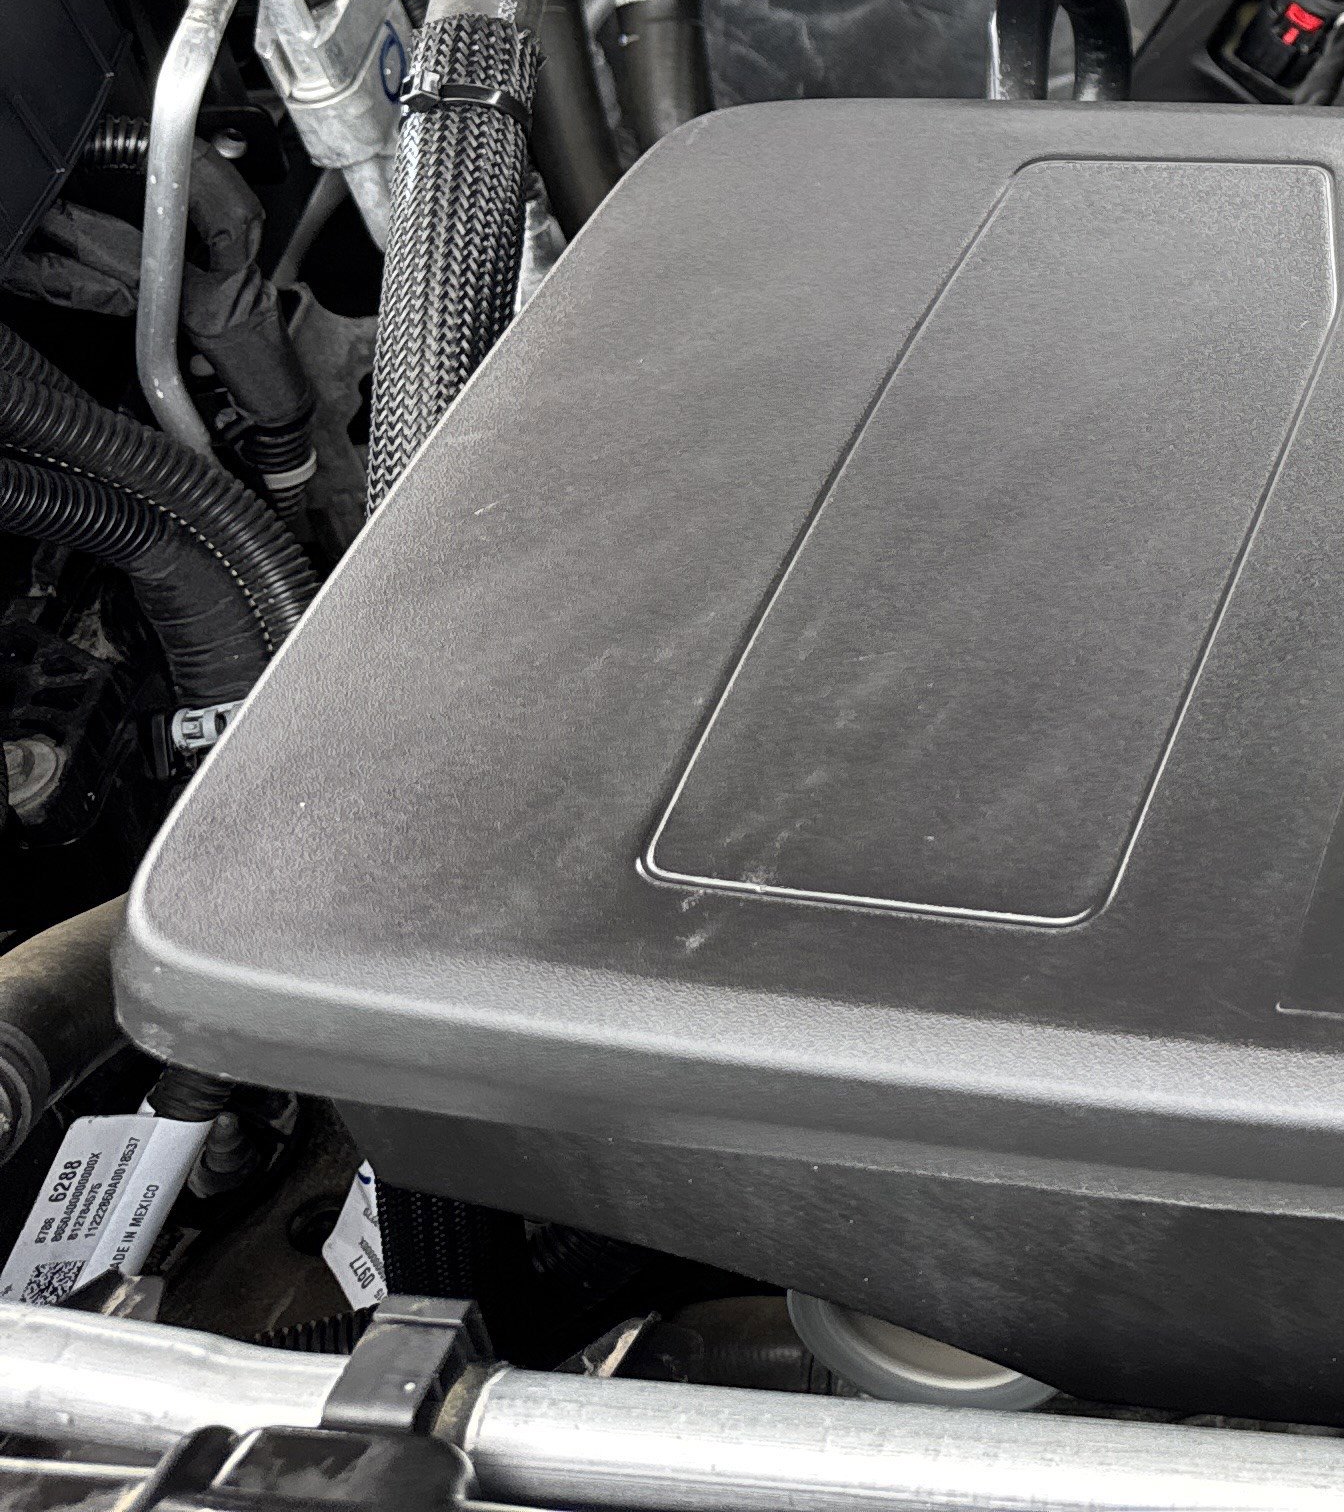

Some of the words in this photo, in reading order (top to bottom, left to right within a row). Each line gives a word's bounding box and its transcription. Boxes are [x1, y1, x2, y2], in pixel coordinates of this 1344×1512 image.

[48, 1159, 82, 1203] 6288
[128, 1184, 160, 1228] MEXICO
[121, 1231, 138, 1243] IN
[348, 1253, 376, 1290] 0977
